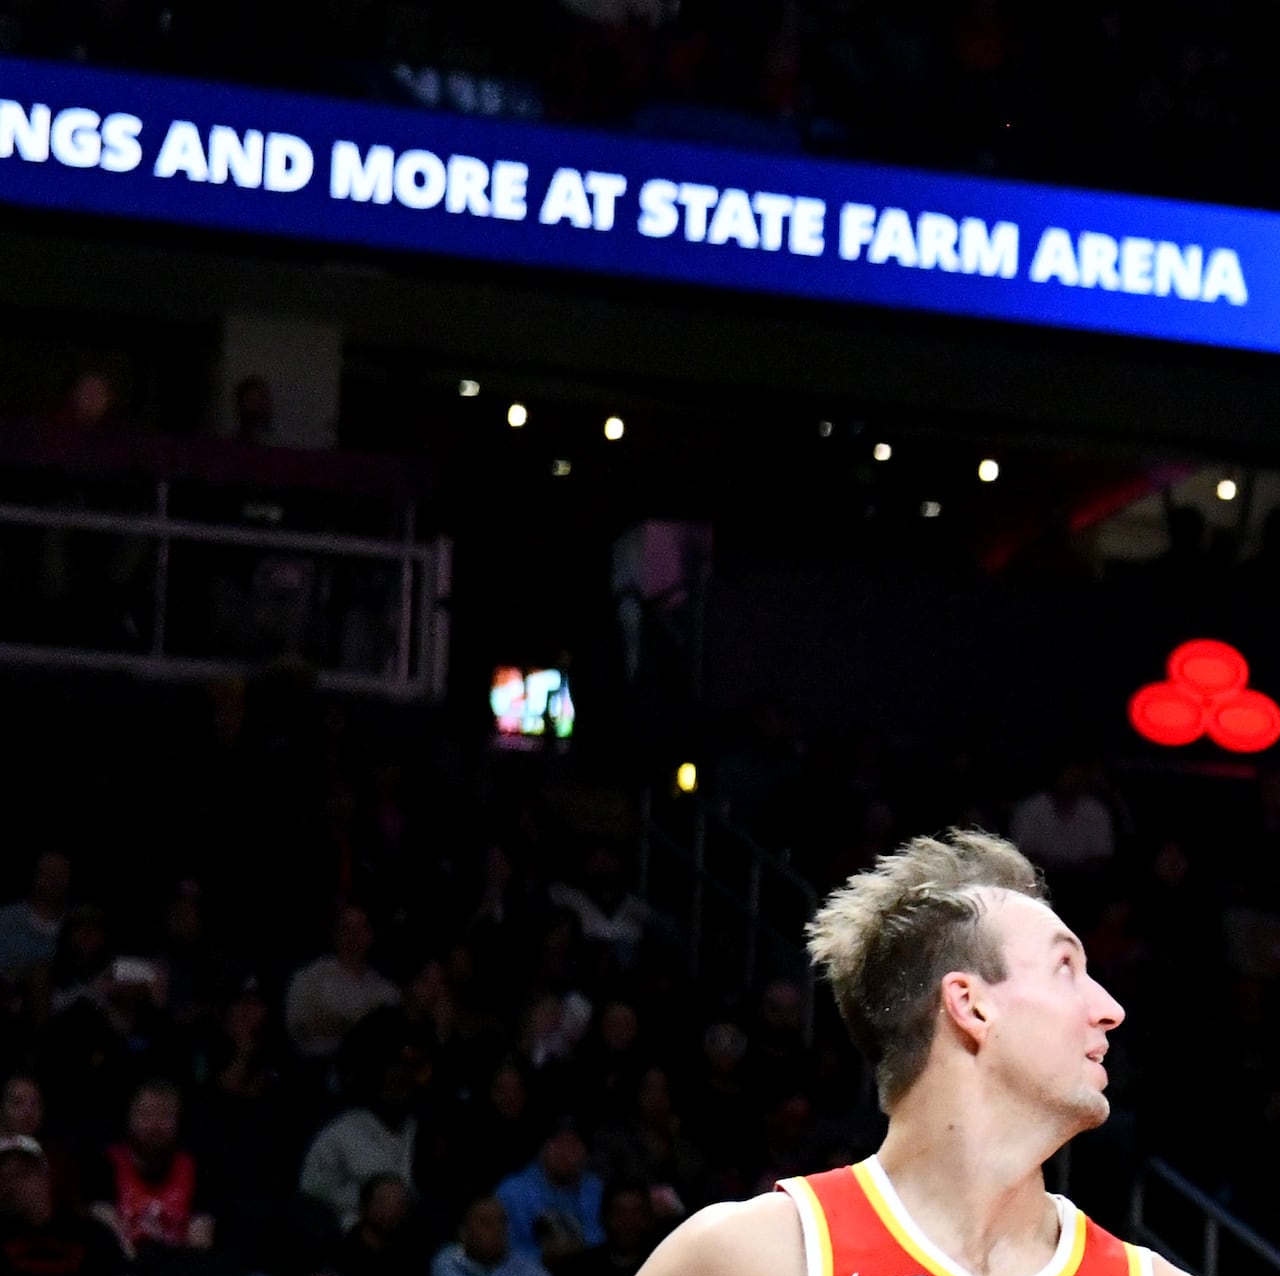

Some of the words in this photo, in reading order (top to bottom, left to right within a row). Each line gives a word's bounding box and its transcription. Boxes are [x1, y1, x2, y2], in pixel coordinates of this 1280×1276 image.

[155, 121, 314, 193] AND
[331, 141, 528, 220] MORE
[541, 169, 627, 231] AT
[638, 179, 825, 256] STATE
[840, 203, 1018, 279] FARM
[1030, 228, 1248, 305] ARENA
